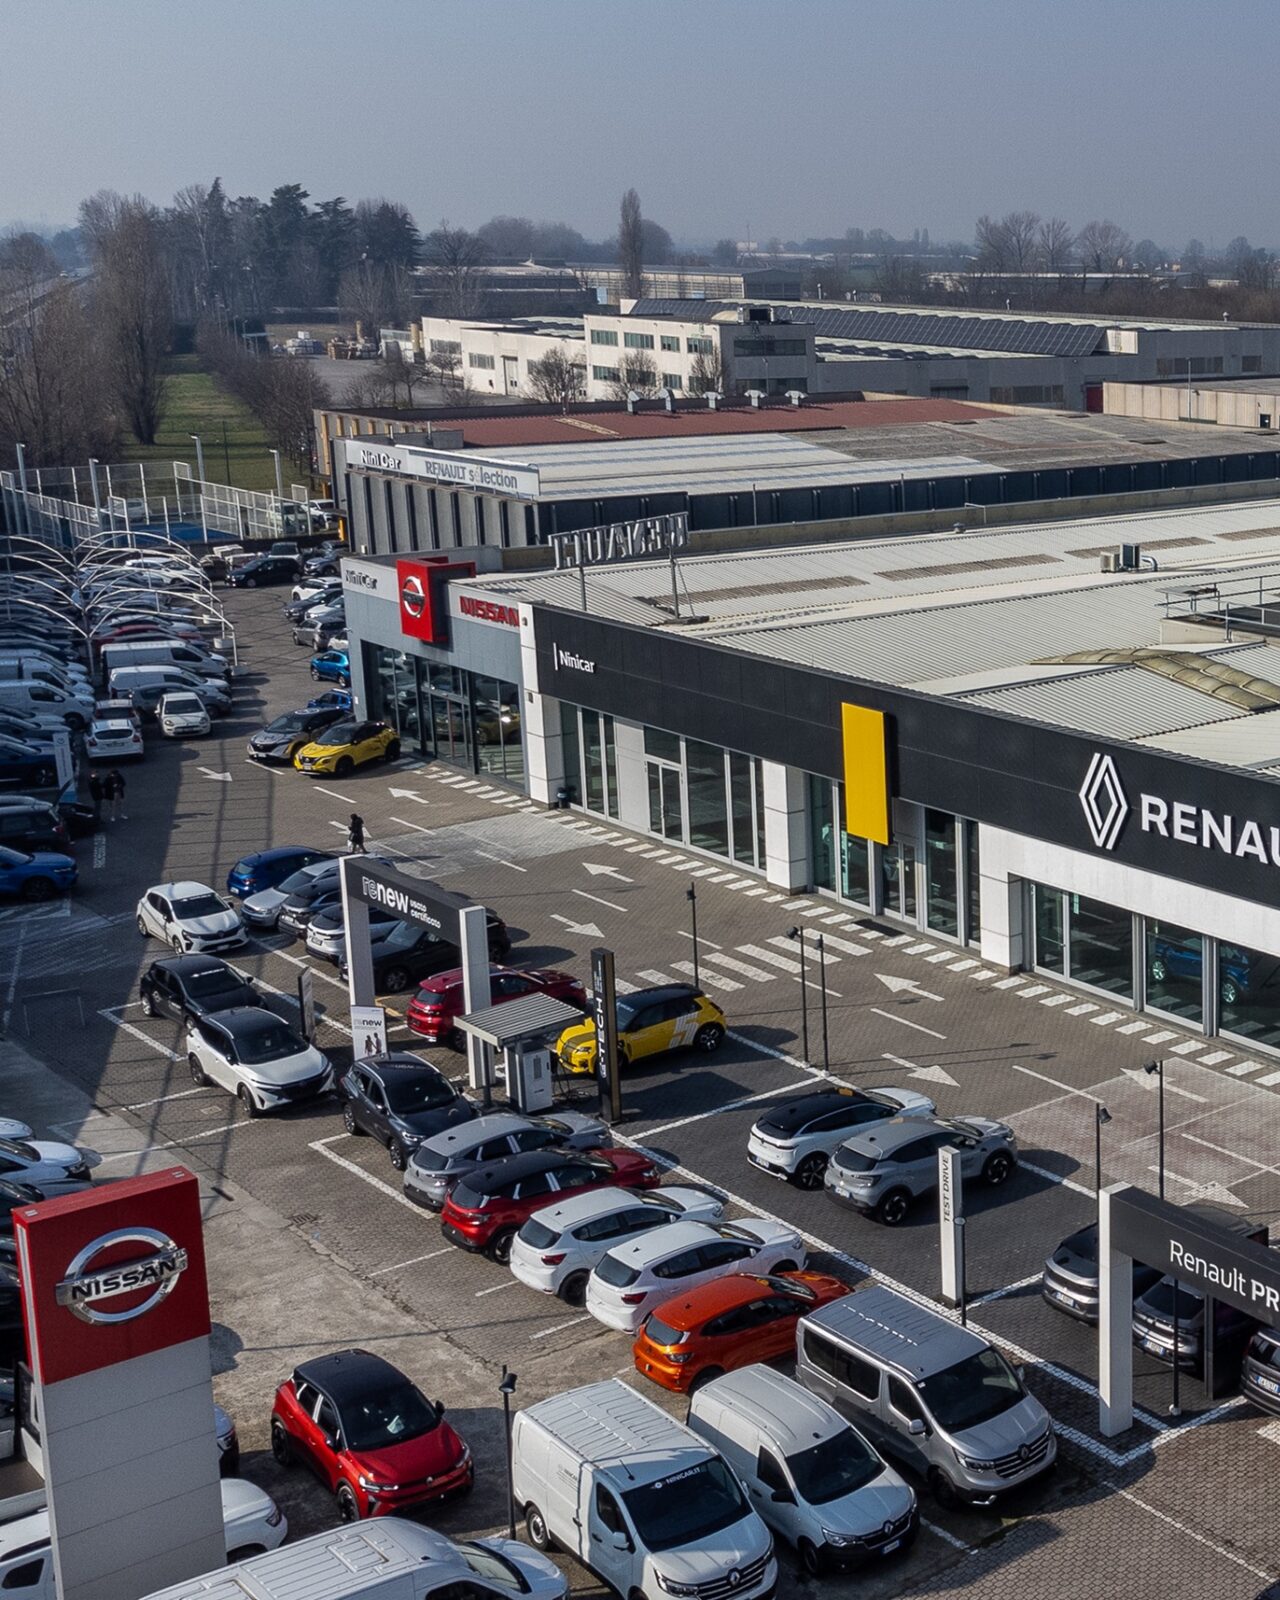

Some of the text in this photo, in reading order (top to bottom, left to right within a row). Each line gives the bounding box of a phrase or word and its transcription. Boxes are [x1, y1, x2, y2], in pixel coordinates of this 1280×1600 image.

[425, 460, 467, 481] RENAULT
[459, 596, 521, 627] NISSAN
[558, 649, 596, 674] Ninicar
[362, 876, 409, 914] renew
[941, 1155, 951, 1223] TEST DRIVE
[71, 1256, 177, 1300] NISSAN
[1169, 1239, 1247, 1297] Renault
